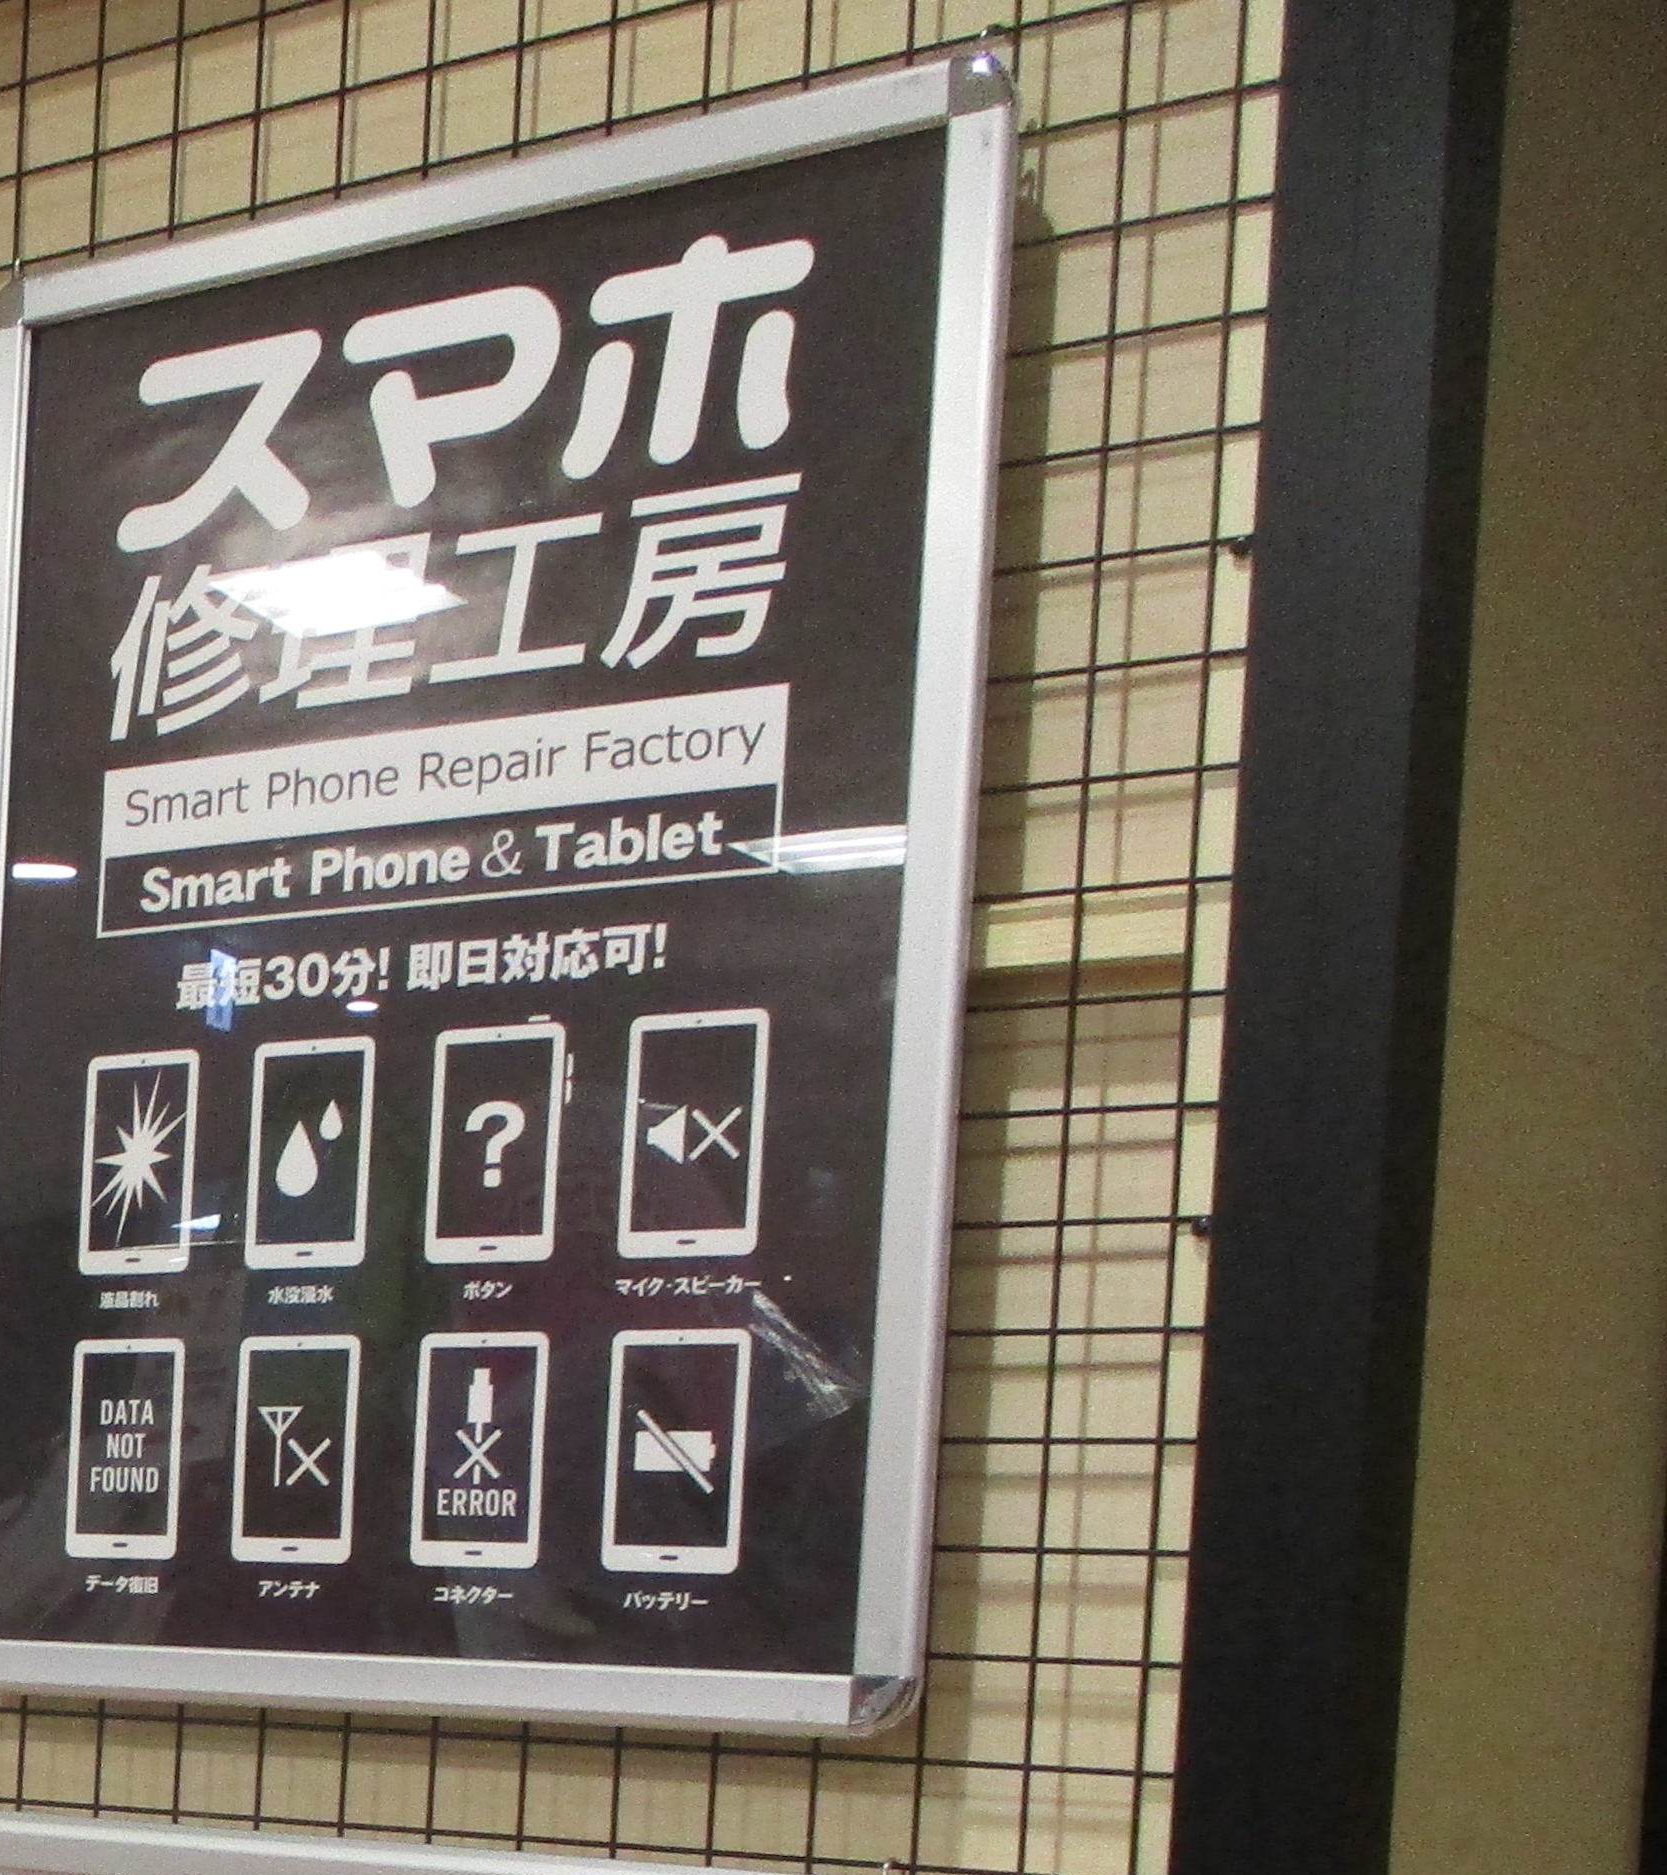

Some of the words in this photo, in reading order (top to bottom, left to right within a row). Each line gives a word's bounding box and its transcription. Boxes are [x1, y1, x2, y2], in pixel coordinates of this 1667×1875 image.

[117, 234, 815, 553] スマホ
[109, 473, 802, 741] 修理工房
[125, 777, 250, 828] Smart
[268, 763, 398, 813] Phone
[419, 738, 566, 796] Repair
[586, 719, 767, 774] Factory
[141, 857, 287, 914] Smart
[310, 840, 469, 896] Phone
[482, 831, 523, 880] &
[535, 812, 724, 872] Tablet
[463, 1279, 514, 1300] ボタン
[99, 1399, 155, 1427] DATA
[105, 1433, 146, 1460] NOT
[89, 1466, 160, 1494] FOUND
[436, 1488, 518, 1519] ERROR
[258, 1580, 320, 1599] アンテナ
[432, 1585, 514, 1606] コネクター
[622, 1591, 710, 1612] バッテリー
